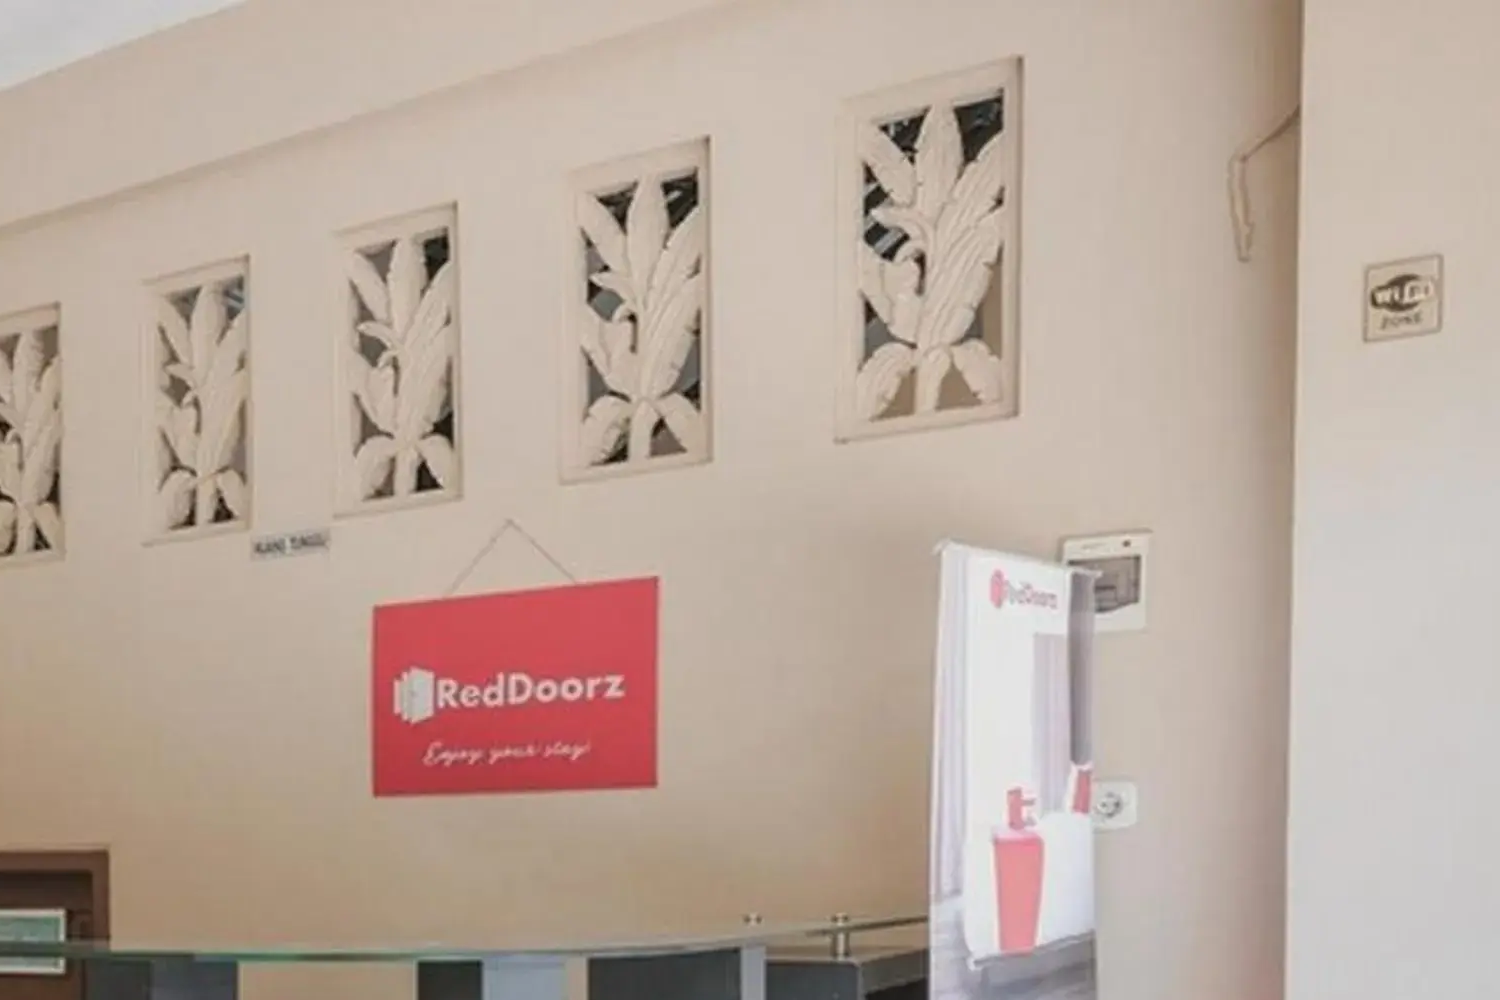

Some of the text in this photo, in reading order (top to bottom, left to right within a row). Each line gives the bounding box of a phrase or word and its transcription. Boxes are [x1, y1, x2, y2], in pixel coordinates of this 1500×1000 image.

[436, 671, 626, 710] RedDoorz
[422, 740, 485, 767] Enjoy
[488, 743, 540, 765] your
